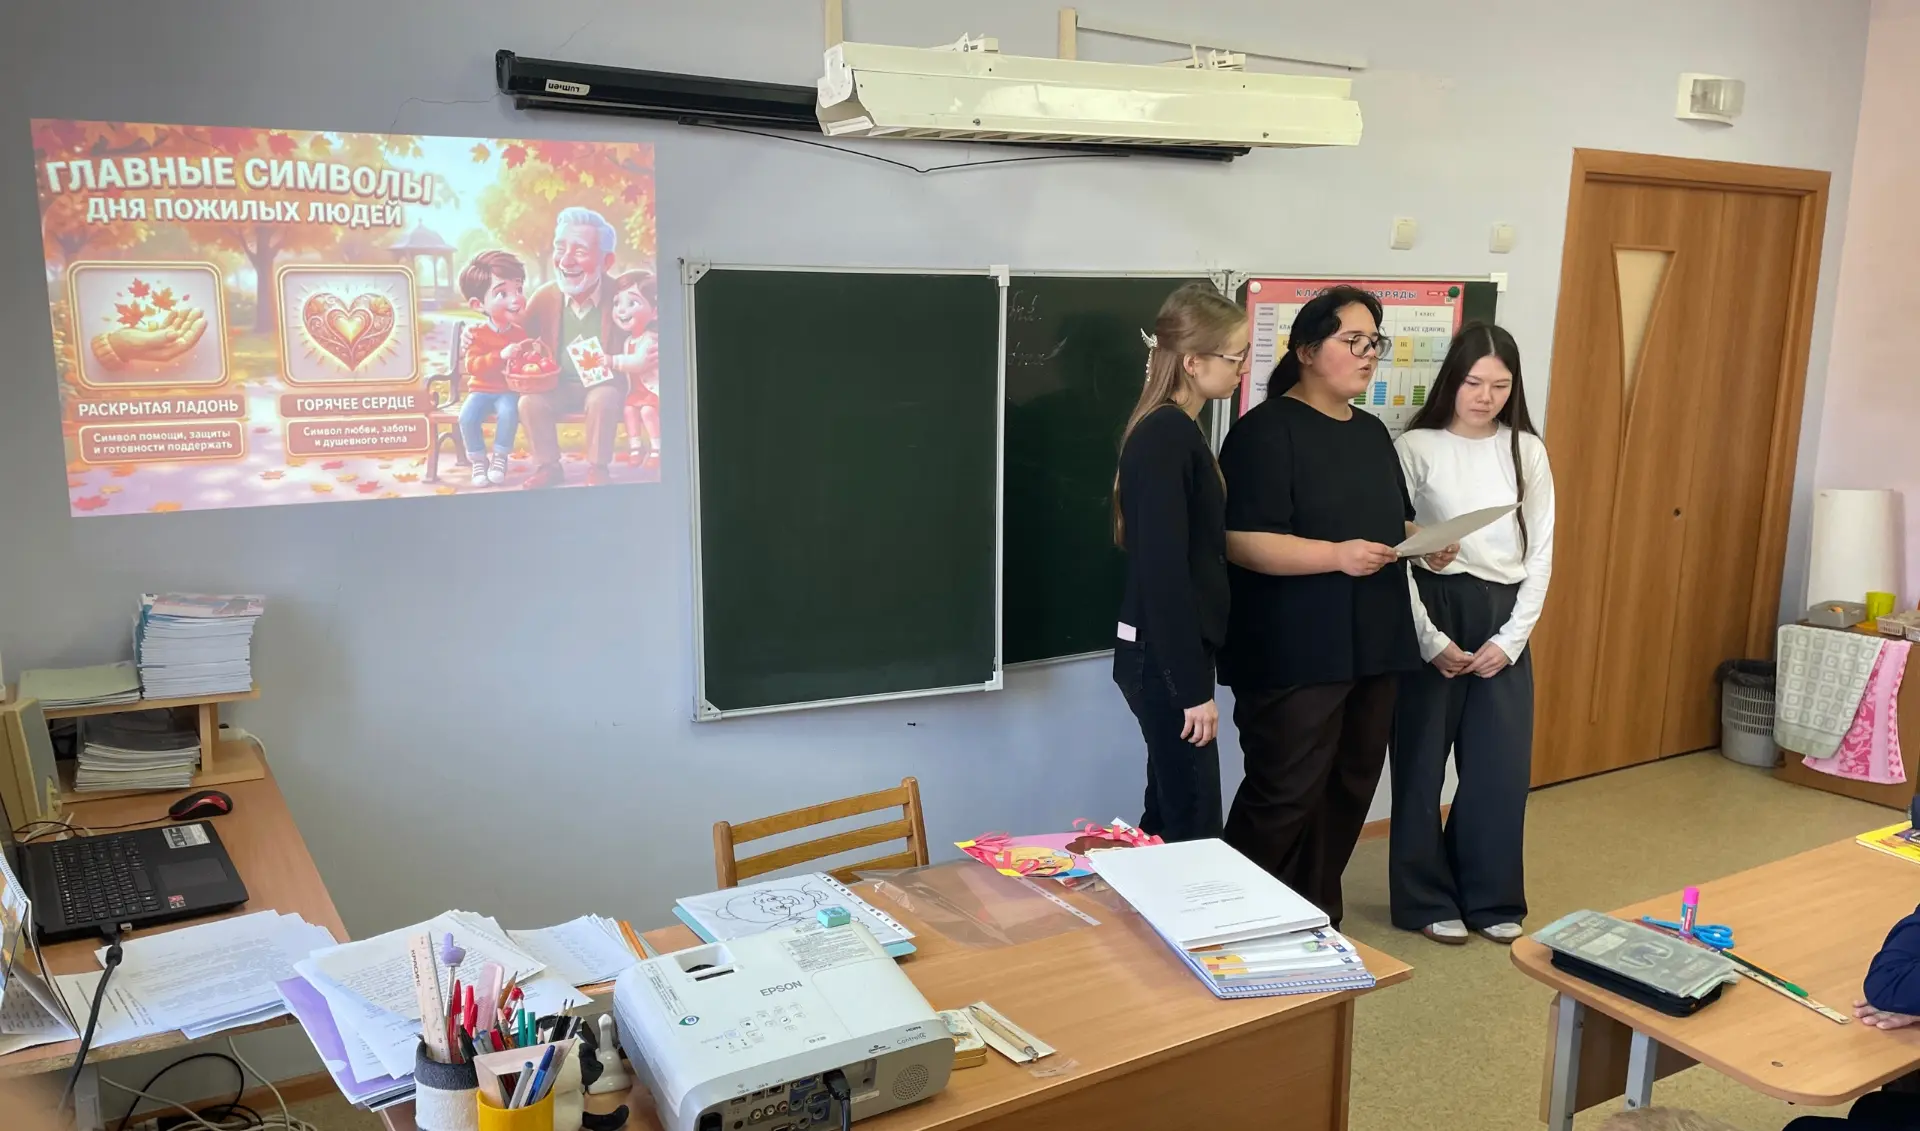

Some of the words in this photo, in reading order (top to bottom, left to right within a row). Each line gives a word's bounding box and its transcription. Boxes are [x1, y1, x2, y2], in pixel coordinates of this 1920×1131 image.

[46, 157, 236, 193] ГЛАВНЫЕ
[244, 158, 434, 205] СИМВОЛЫ
[86, 198, 147, 224] ДНЯ
[153, 198, 301, 222] ПОЖИЛЫХ
[307, 200, 403, 229] ЛЮДЕЙ
[1366, 290, 1416, 299] АЗРЯДЫ
[78, 401, 171, 416] РАСКРЫТАЯ
[175, 399, 239, 414] ЛАДОНЬ
[296, 397, 359, 411] ГОРЯЧЕЕ
[362, 396, 415, 410] СЕРДЦЕ
[93, 433, 137, 443] Символ
[139, 432, 187, 442] помощи,
[189, 430, 231, 440] защиты
[303, 427, 342, 436] Символ
[344, 425, 380, 435] любви,
[382, 424, 416, 433] заботы
[103, 444, 165, 454] готовности
[167, 441, 233, 452] поддержать
[323, 437, 377, 448] душевного
[380, 436, 407, 444] тепла
[760, 980, 803, 996] EPSON
